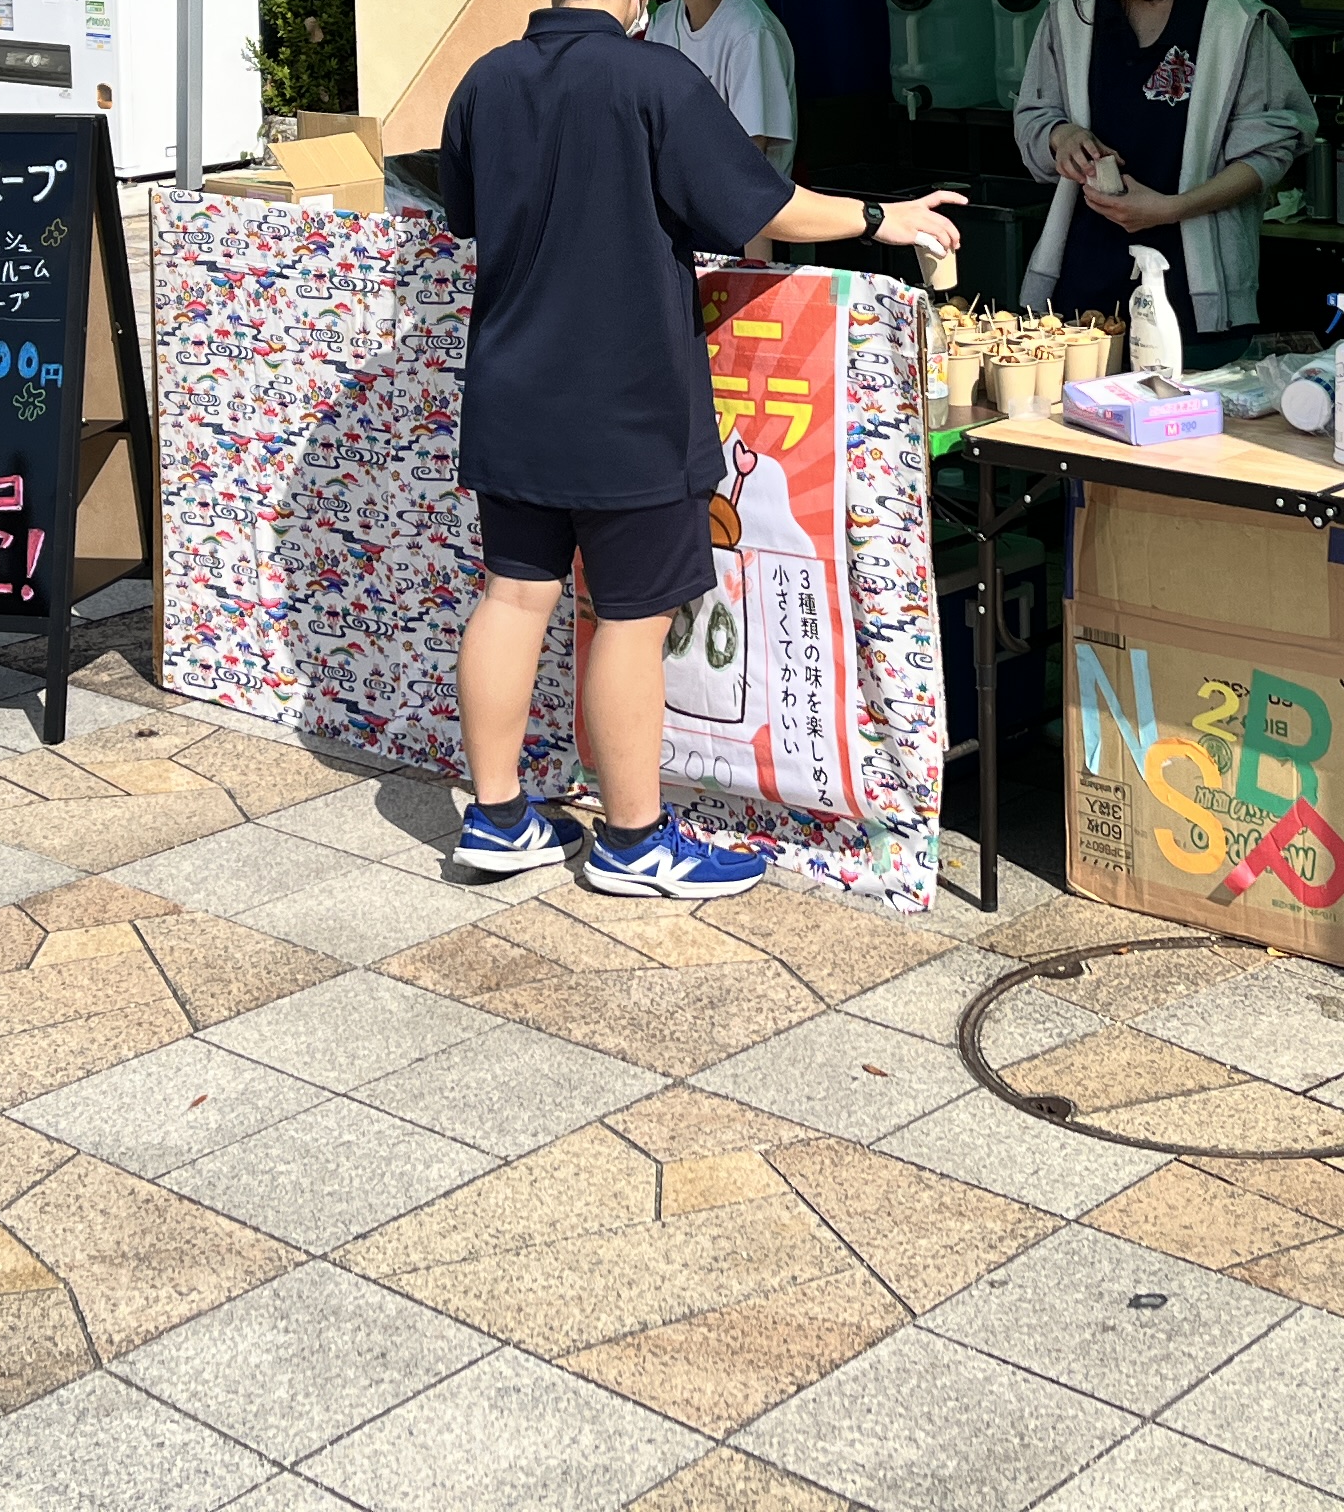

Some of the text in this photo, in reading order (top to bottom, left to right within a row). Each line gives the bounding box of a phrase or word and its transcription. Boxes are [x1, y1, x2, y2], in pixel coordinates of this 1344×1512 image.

[1, 259, 51, 284] ルーム
[771, 564, 801, 755] 小さくてかわいい
[797, 568, 834, 808] 3種類の味を楽しめる
